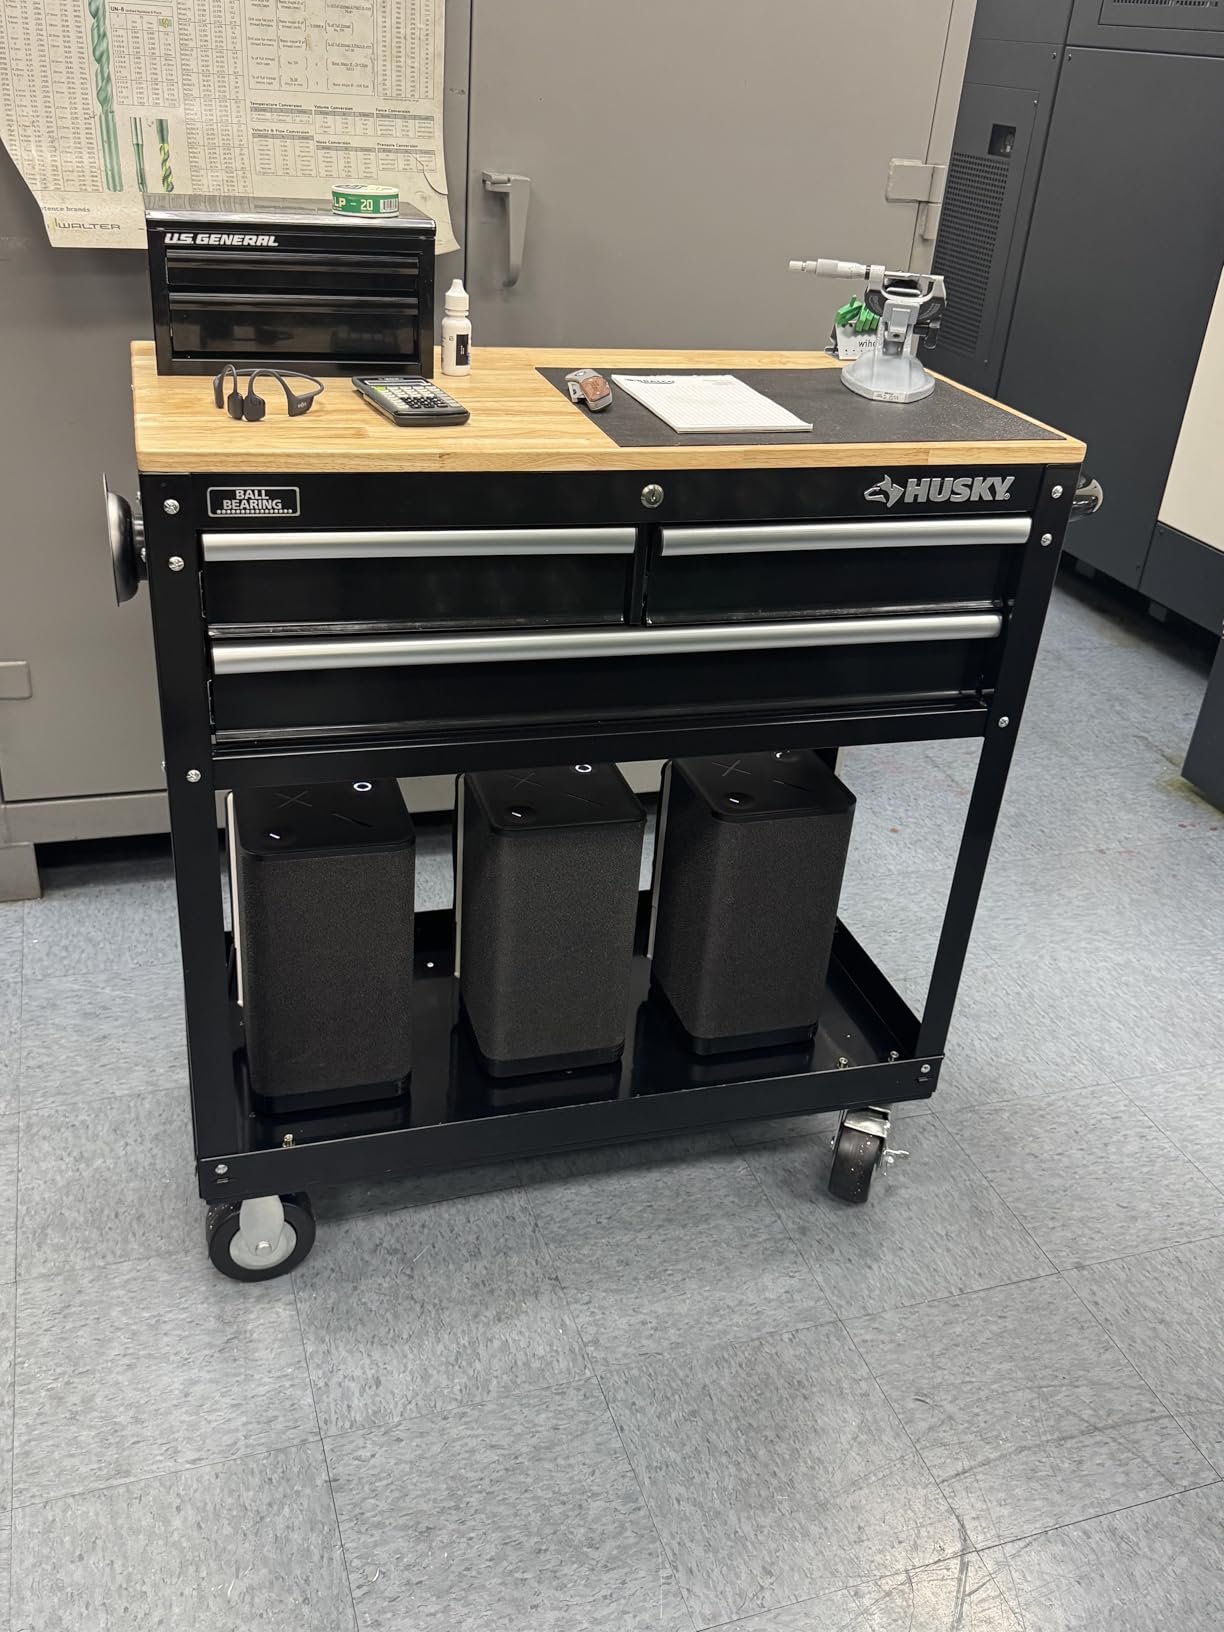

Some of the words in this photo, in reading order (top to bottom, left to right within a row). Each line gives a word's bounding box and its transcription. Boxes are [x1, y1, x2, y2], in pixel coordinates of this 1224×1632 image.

[360, 199, 373, 211] 20
[58, 222, 121, 230] WALTER
[195, 233, 279, 247] GENERAL
[235, 489, 270, 500] BALL
[222, 499, 282, 510] BEARING
